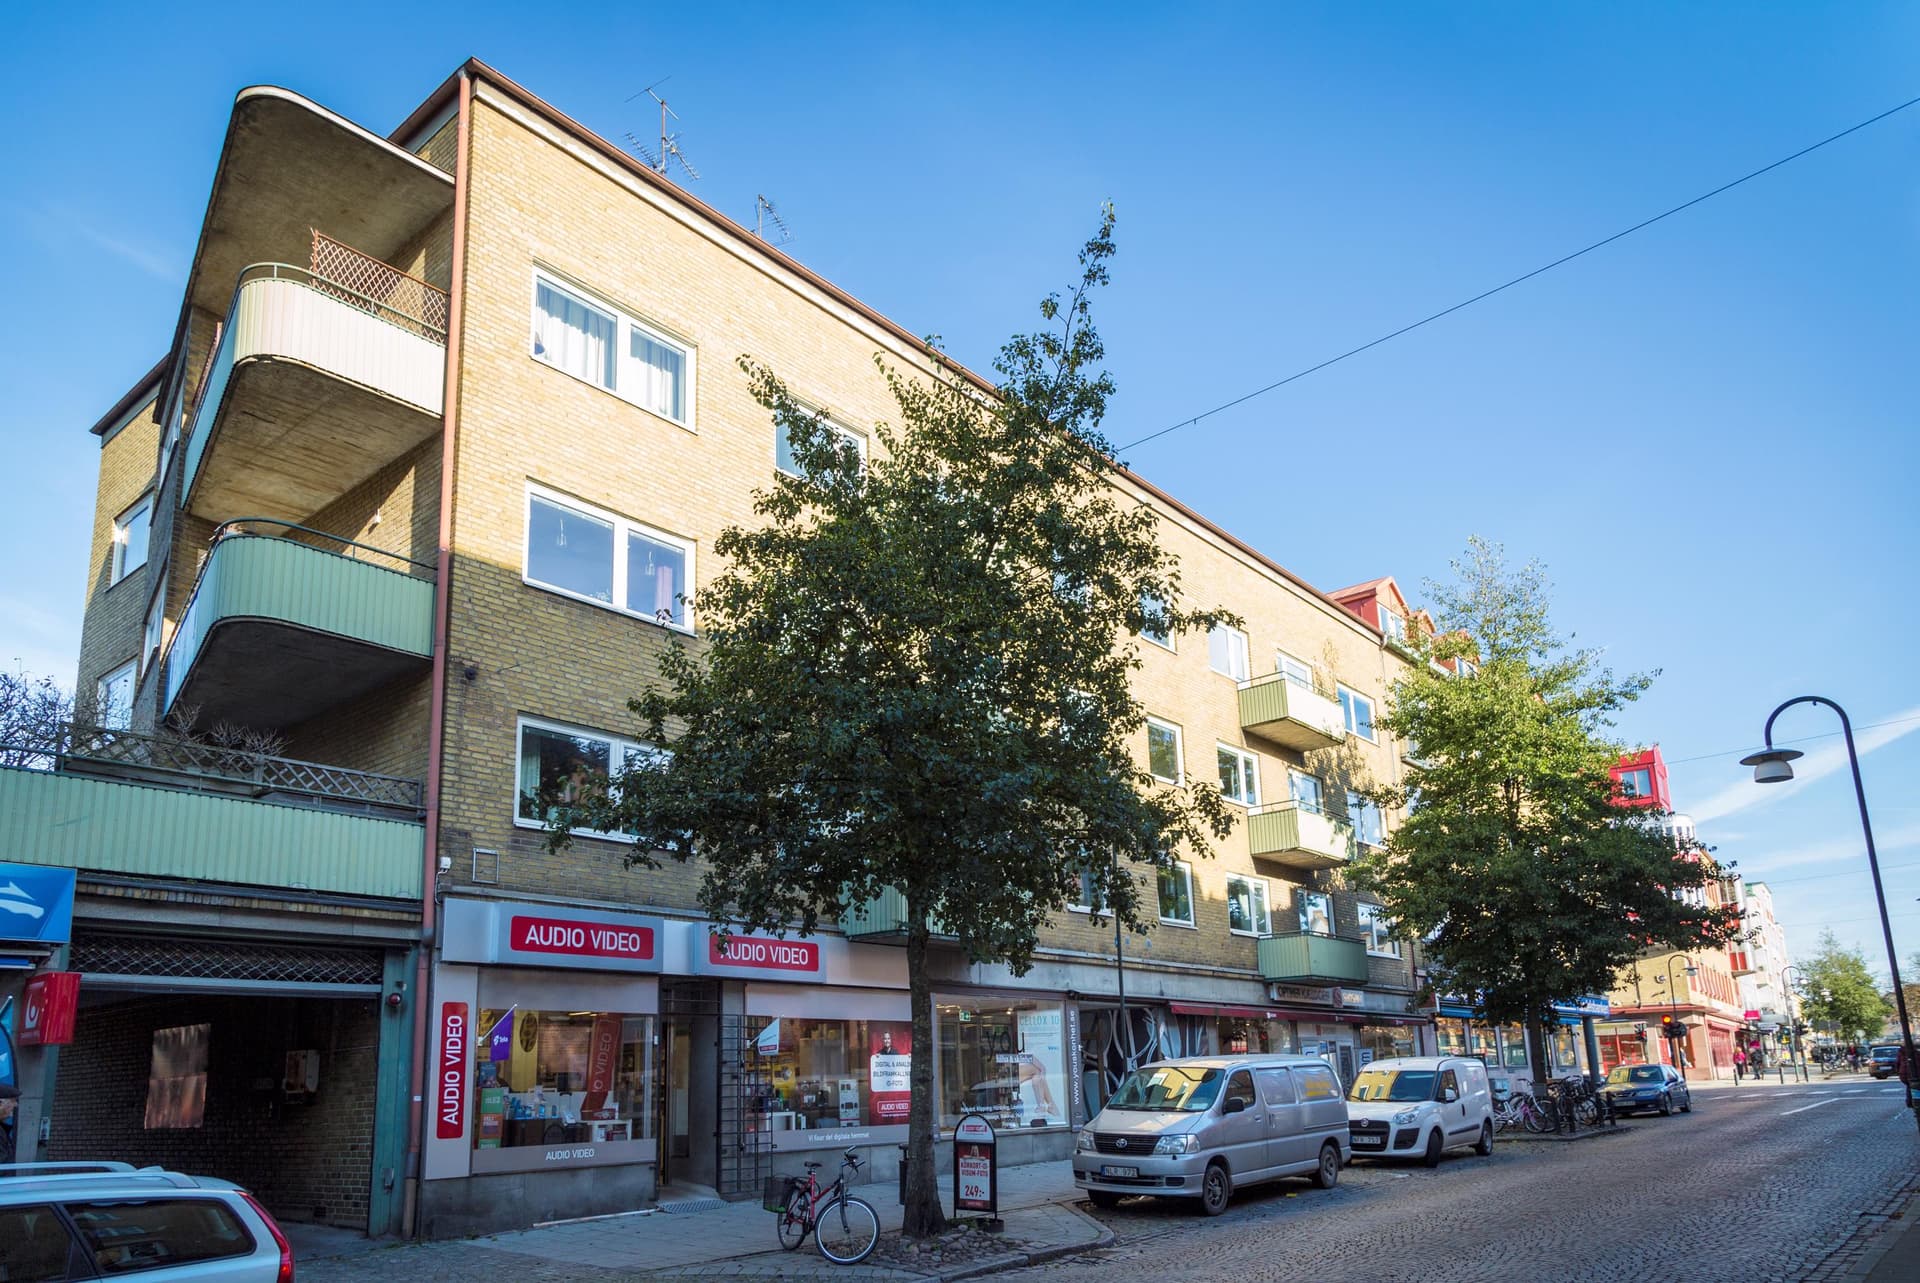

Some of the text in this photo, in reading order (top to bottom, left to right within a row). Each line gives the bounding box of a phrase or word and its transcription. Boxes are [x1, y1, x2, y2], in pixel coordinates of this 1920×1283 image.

[525, 924, 640, 952] AUDIO VIDEO
[720, 943, 809, 965] AUDIO VIDEO
[442, 1015, 463, 1125] AUDIO VIDEO
[545, 1148, 595, 1161] AUDIO VIDEO
[964, 1185, 985, 1197] 249:-
